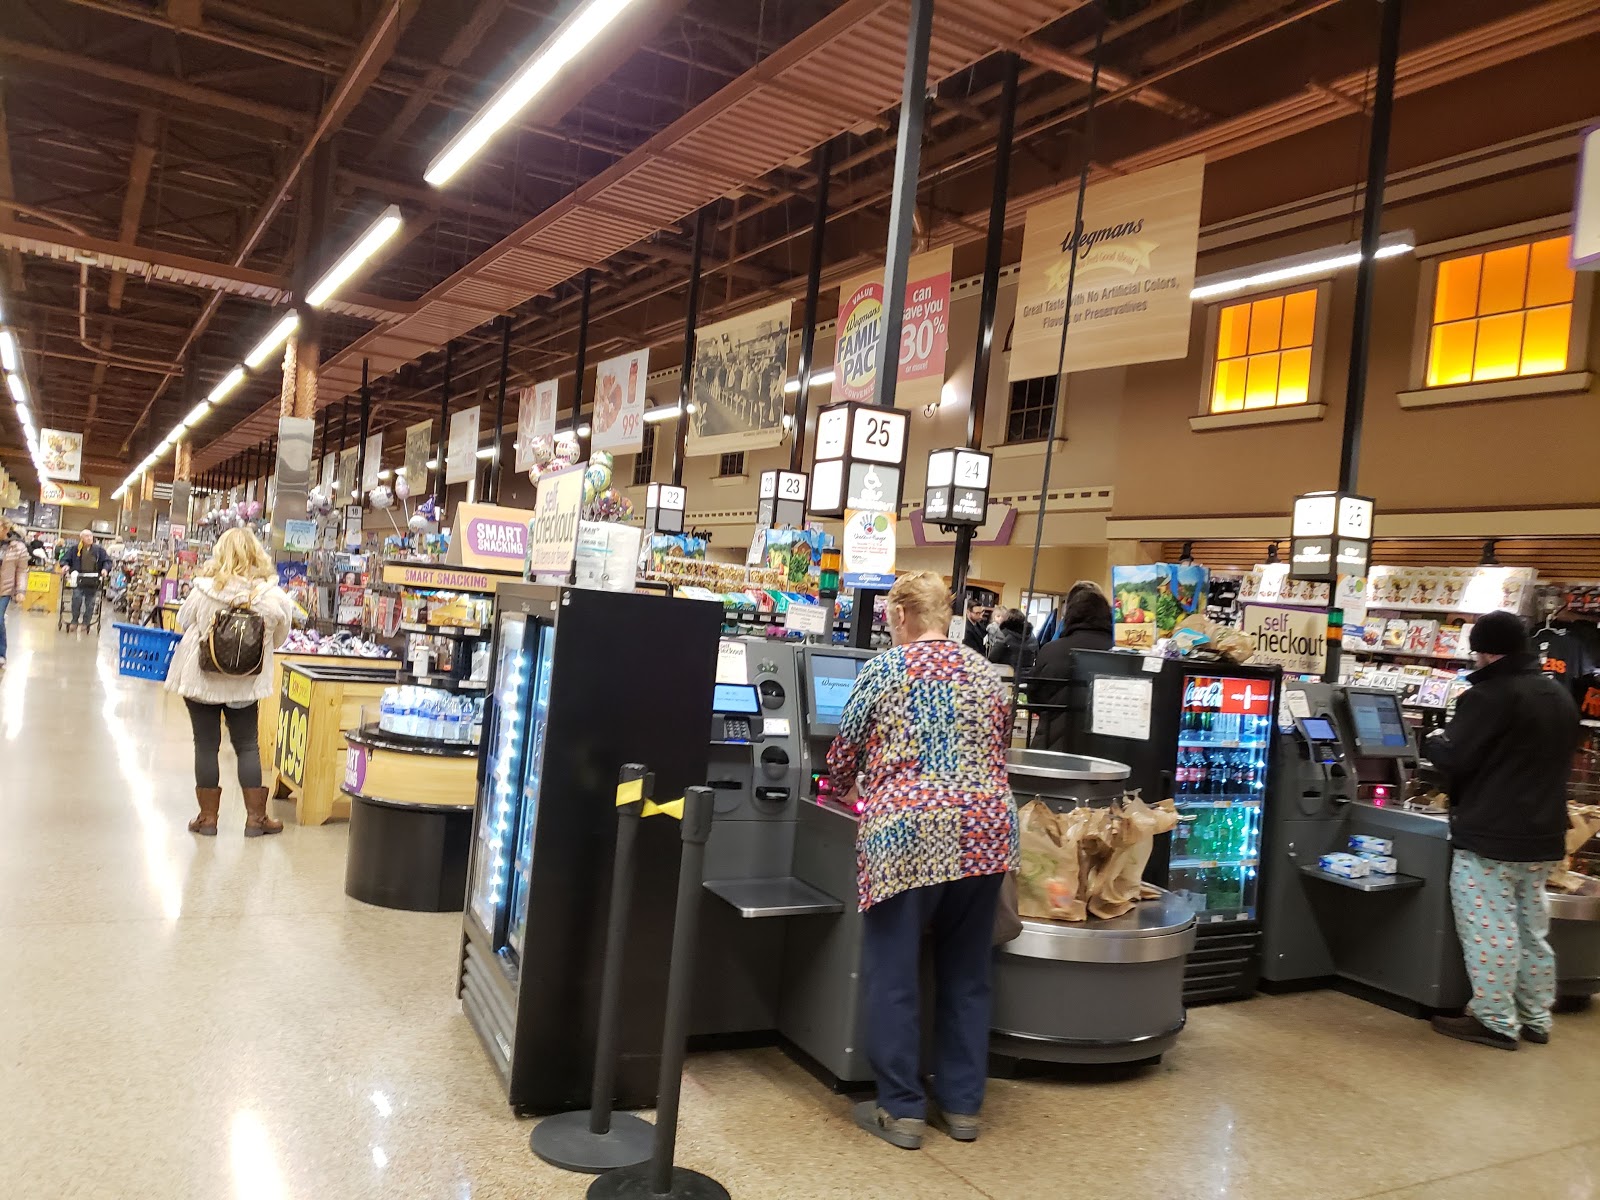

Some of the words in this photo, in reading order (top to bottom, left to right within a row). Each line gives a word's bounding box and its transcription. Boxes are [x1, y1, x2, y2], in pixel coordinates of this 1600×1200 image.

[1060, 218, 1144, 259] Wegmans
[852, 286, 874, 305] VALUE
[912, 285, 932, 304] can
[1023, 303, 1043, 318] Great
[1044, 297, 1065, 312] Taste
[1087, 290, 1099, 303] No
[1101, 281, 1140, 301] Artificial
[1144, 276, 1180, 294] Colors,
[923, 298, 944, 318] you
[1074, 312, 1083, 323] or
[1084, 300, 1147, 321] Preservatives
[846, 305, 881, 334] Wegmans
[837, 317, 882, 364] FAMIL
[843, 343, 878, 386] PAC
[866, 417, 892, 447] 25
[965, 460, 980, 479] 24
[545, 480, 560, 513] self
[786, 478, 800, 494] 23
[667, 490, 680, 505] 22
[476, 522, 523, 543] SMART
[535, 502, 577, 545] checkout
[477, 539, 524, 555] SNACKING
[404, 569, 435, 584] SMART
[436, 572, 488, 589] SNACKING
[1263, 612, 1290, 632] self
[821, 677, 850, 690] Wegmans
[277, 706, 307, 785] $1.99
